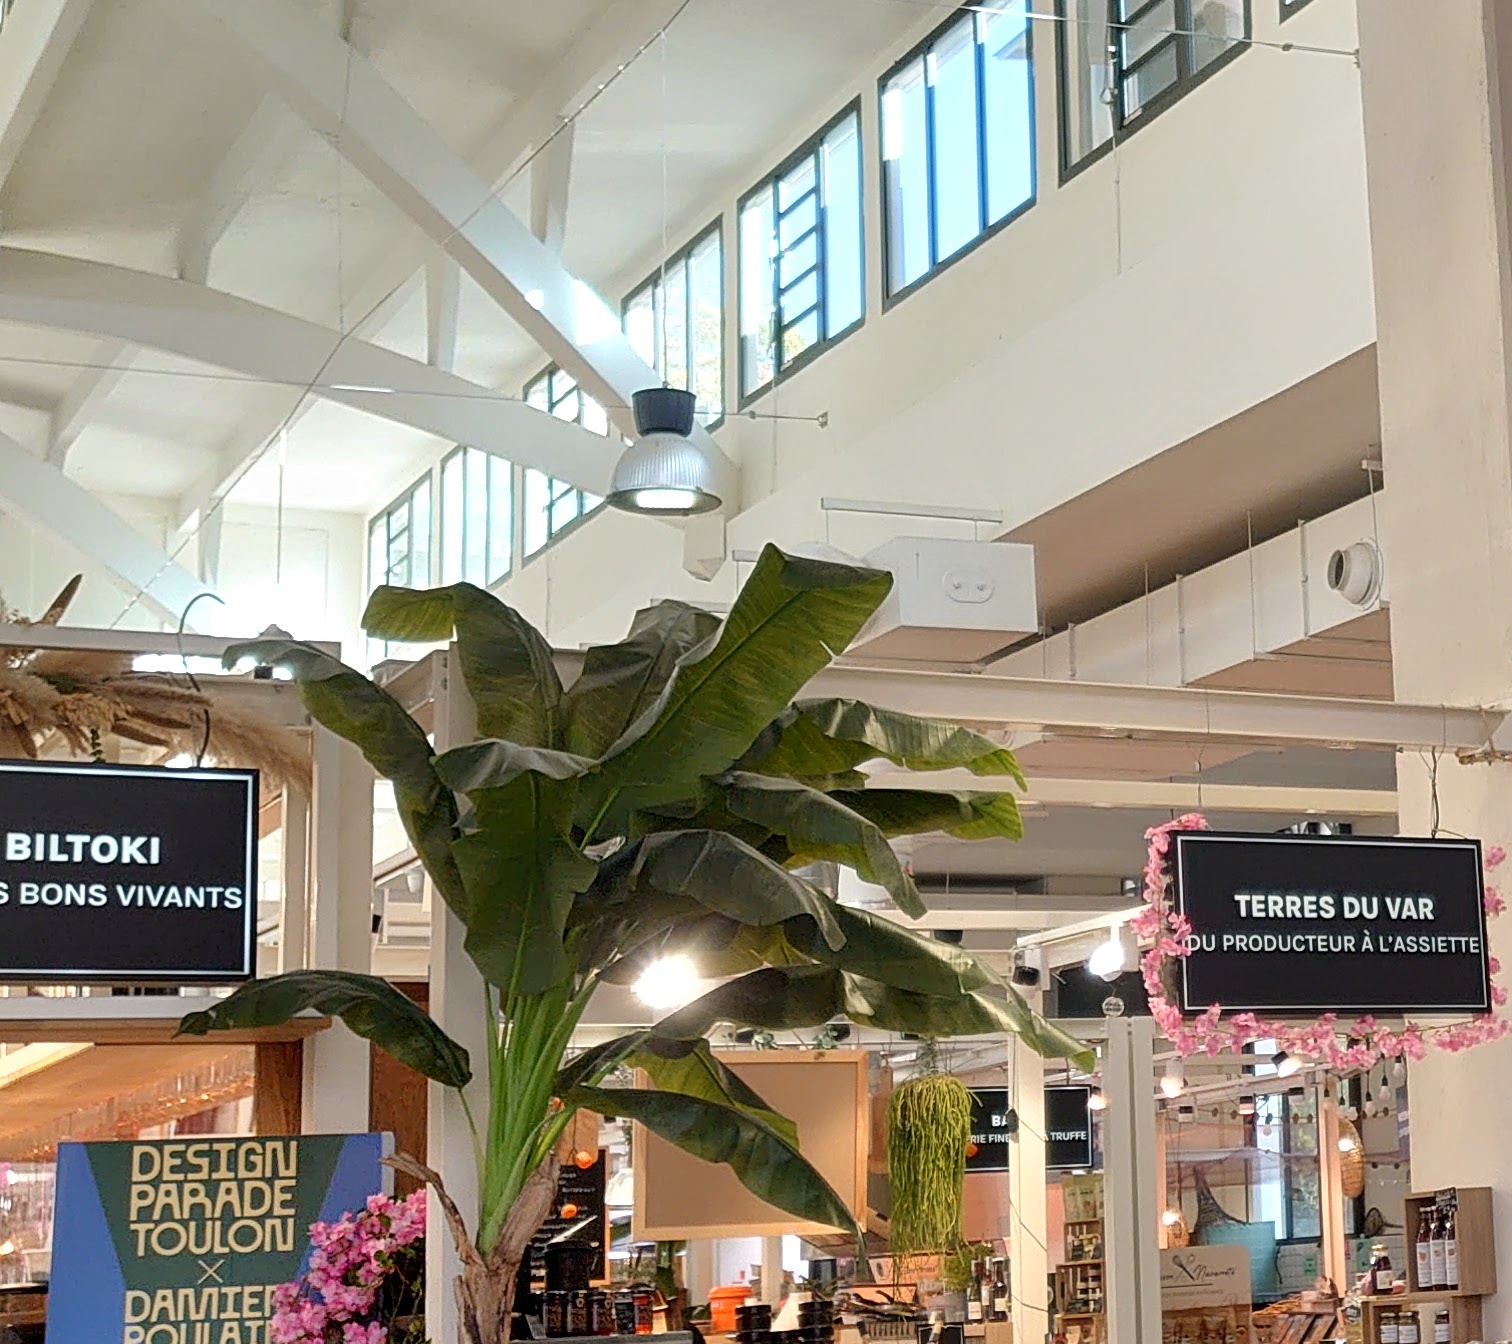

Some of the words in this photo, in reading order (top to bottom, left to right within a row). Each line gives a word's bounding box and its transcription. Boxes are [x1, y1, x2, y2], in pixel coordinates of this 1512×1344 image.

[5, 831, 161, 866] BILTOKI
[19, 882, 108, 907] BONS
[115, 884, 243, 910] VIVANTS
[1233, 893, 1336, 920] TERRES
[1342, 895, 1380, 920] DU
[1384, 896, 1436, 921] VAR
[1188, 933, 1217, 953] DU
[1222, 933, 1357, 954] PRODUCTEUR
[1360, 928, 1375, 954] À
[1378, 934, 1480, 954] L'ASSIETTE
[1049, 1130, 1088, 1142] TRUFFE
[131, 1140, 298, 1183] DESIGN
[129, 1178, 297, 1222] PARADE
[129, 1217, 295, 1258] TOULON
